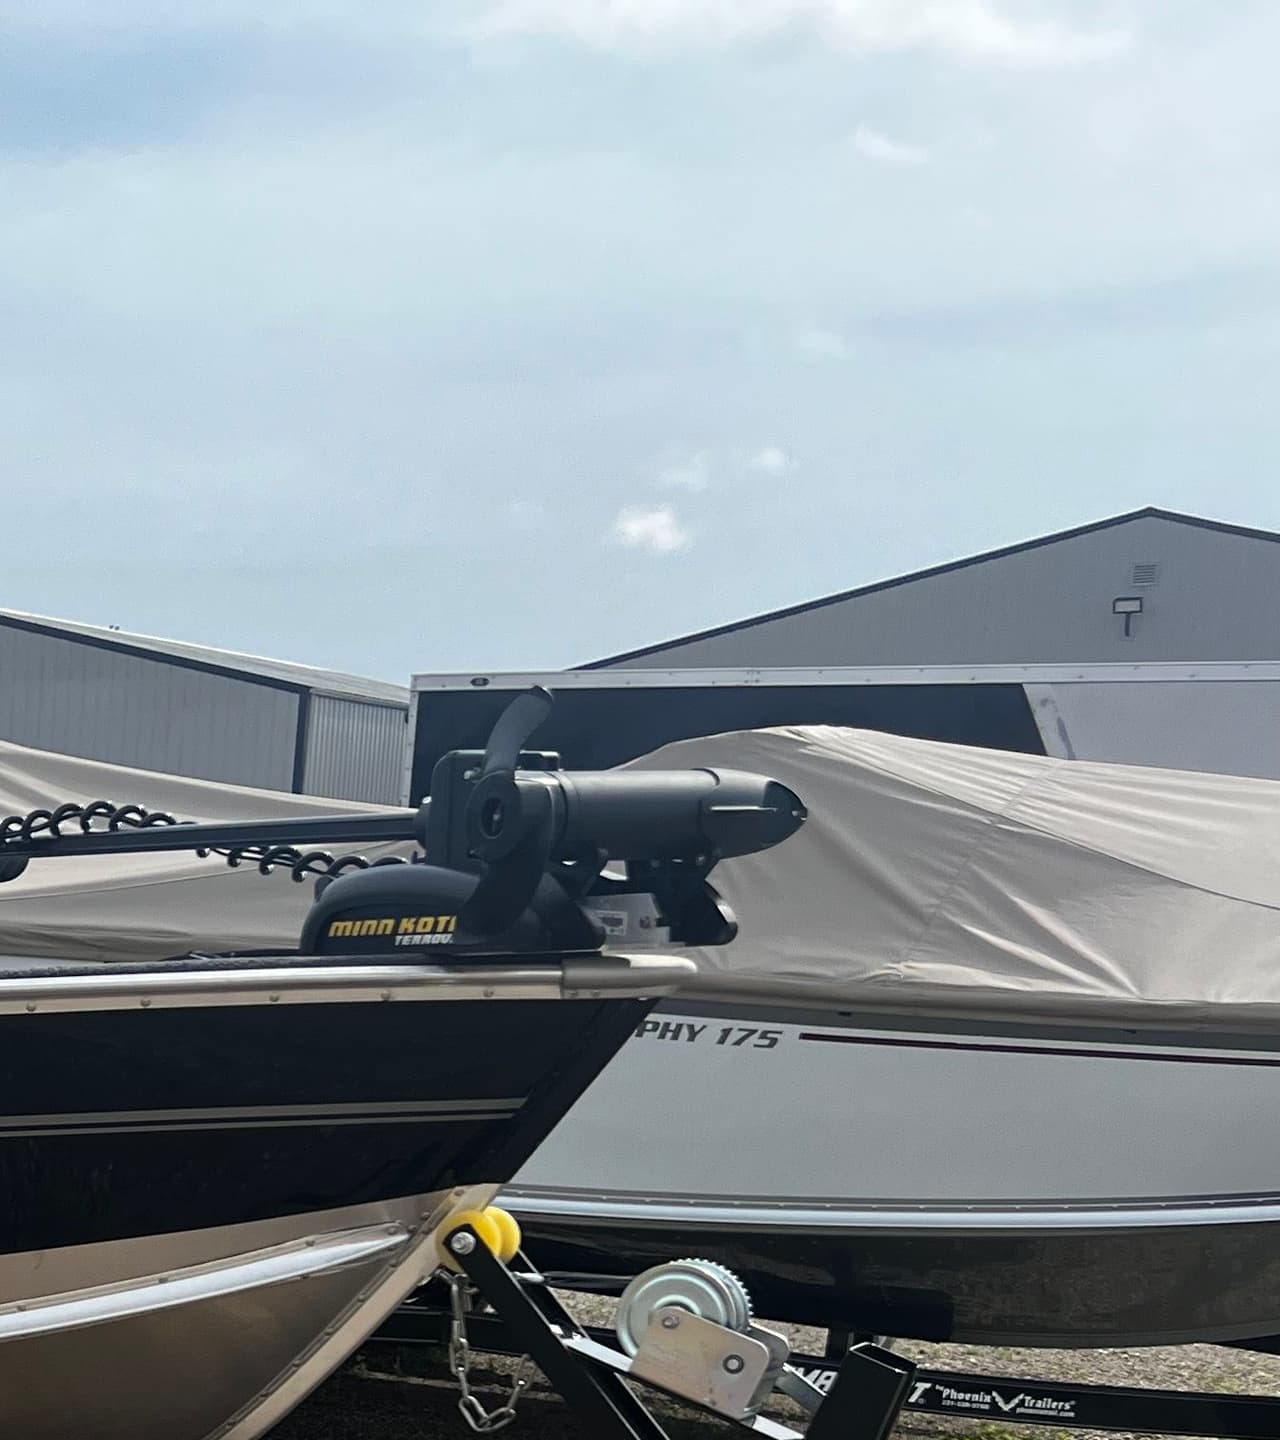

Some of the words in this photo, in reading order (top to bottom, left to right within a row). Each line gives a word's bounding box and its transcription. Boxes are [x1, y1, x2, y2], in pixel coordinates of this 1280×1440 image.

[328, 918, 396, 937] MINN
[394, 933, 454, 946] TERROV
[715, 1027, 784, 1049] 175
[942, 1388, 991, 1403] Phoenix
[1023, 1396, 1071, 1410] Trailers
